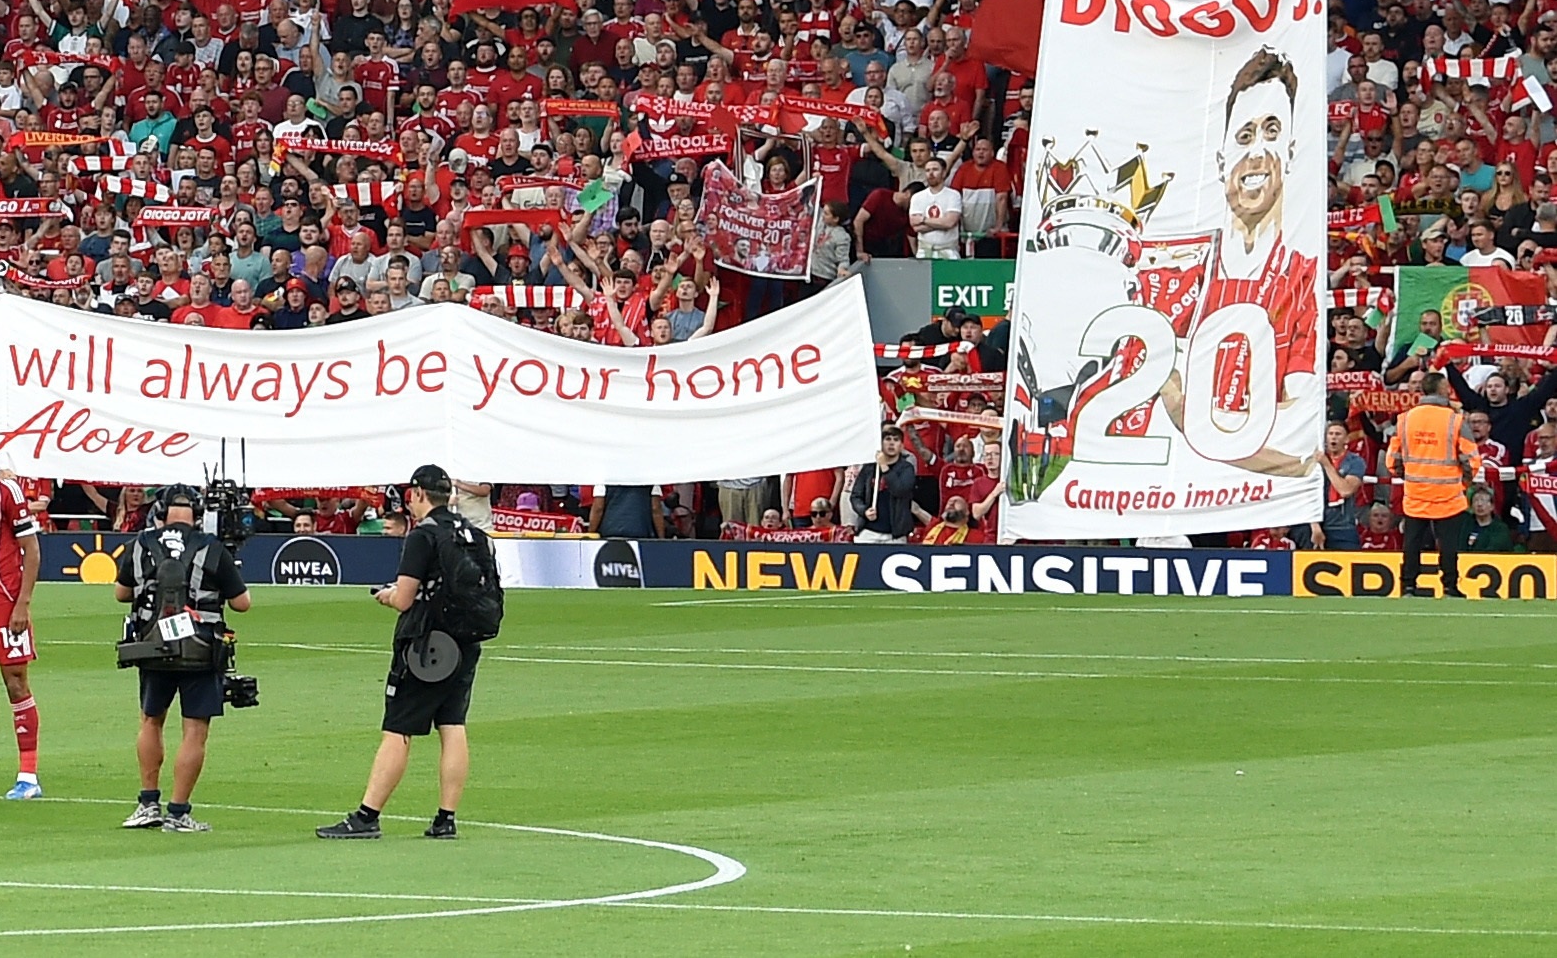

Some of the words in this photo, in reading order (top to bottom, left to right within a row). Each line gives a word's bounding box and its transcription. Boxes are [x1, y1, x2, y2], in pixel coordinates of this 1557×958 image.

[859, 108, 876, 120] FC
[1335, 102, 1350, 113] FC
[24, 131, 93, 143] LIVERPOOL
[712, 133, 728, 146] FC
[306, 139, 328, 150] ARE
[331, 140, 394, 156] LIVERPOOL
[20, 201, 33, 213] J.
[142, 208, 180, 221] DIOGO
[180, 209, 210, 222] JOTA
[1349, 208, 1365, 222] FC
[719, 205, 767, 230] FOREVER
[767, 218, 793, 231] OUR
[718, 218, 764, 242] NUMBER
[763, 228, 780, 245] 20
[938, 285, 994, 308] EXIT
[1505, 309, 1523, 326] 20
[9, 334, 114, 395] will
[140, 344, 353, 418] always
[375, 339, 448, 397] be
[472, 354, 620, 411] your
[646, 343, 822, 403] home
[1071, 302, 1277, 467] 20
[1064, 479, 1176, 515] Campeão
[1185, 479, 1272, 509] imortal
[492, 513, 523, 527] IOGO
[524, 516, 556, 531] JOTA
[280, 560, 334, 576] NIVEA
[601, 562, 640, 579] NIVEA
[692, 550, 860, 591] NEW
[880, 553, 1269, 597] SENSITIVE
[1466, 564, 1548, 598] 30
